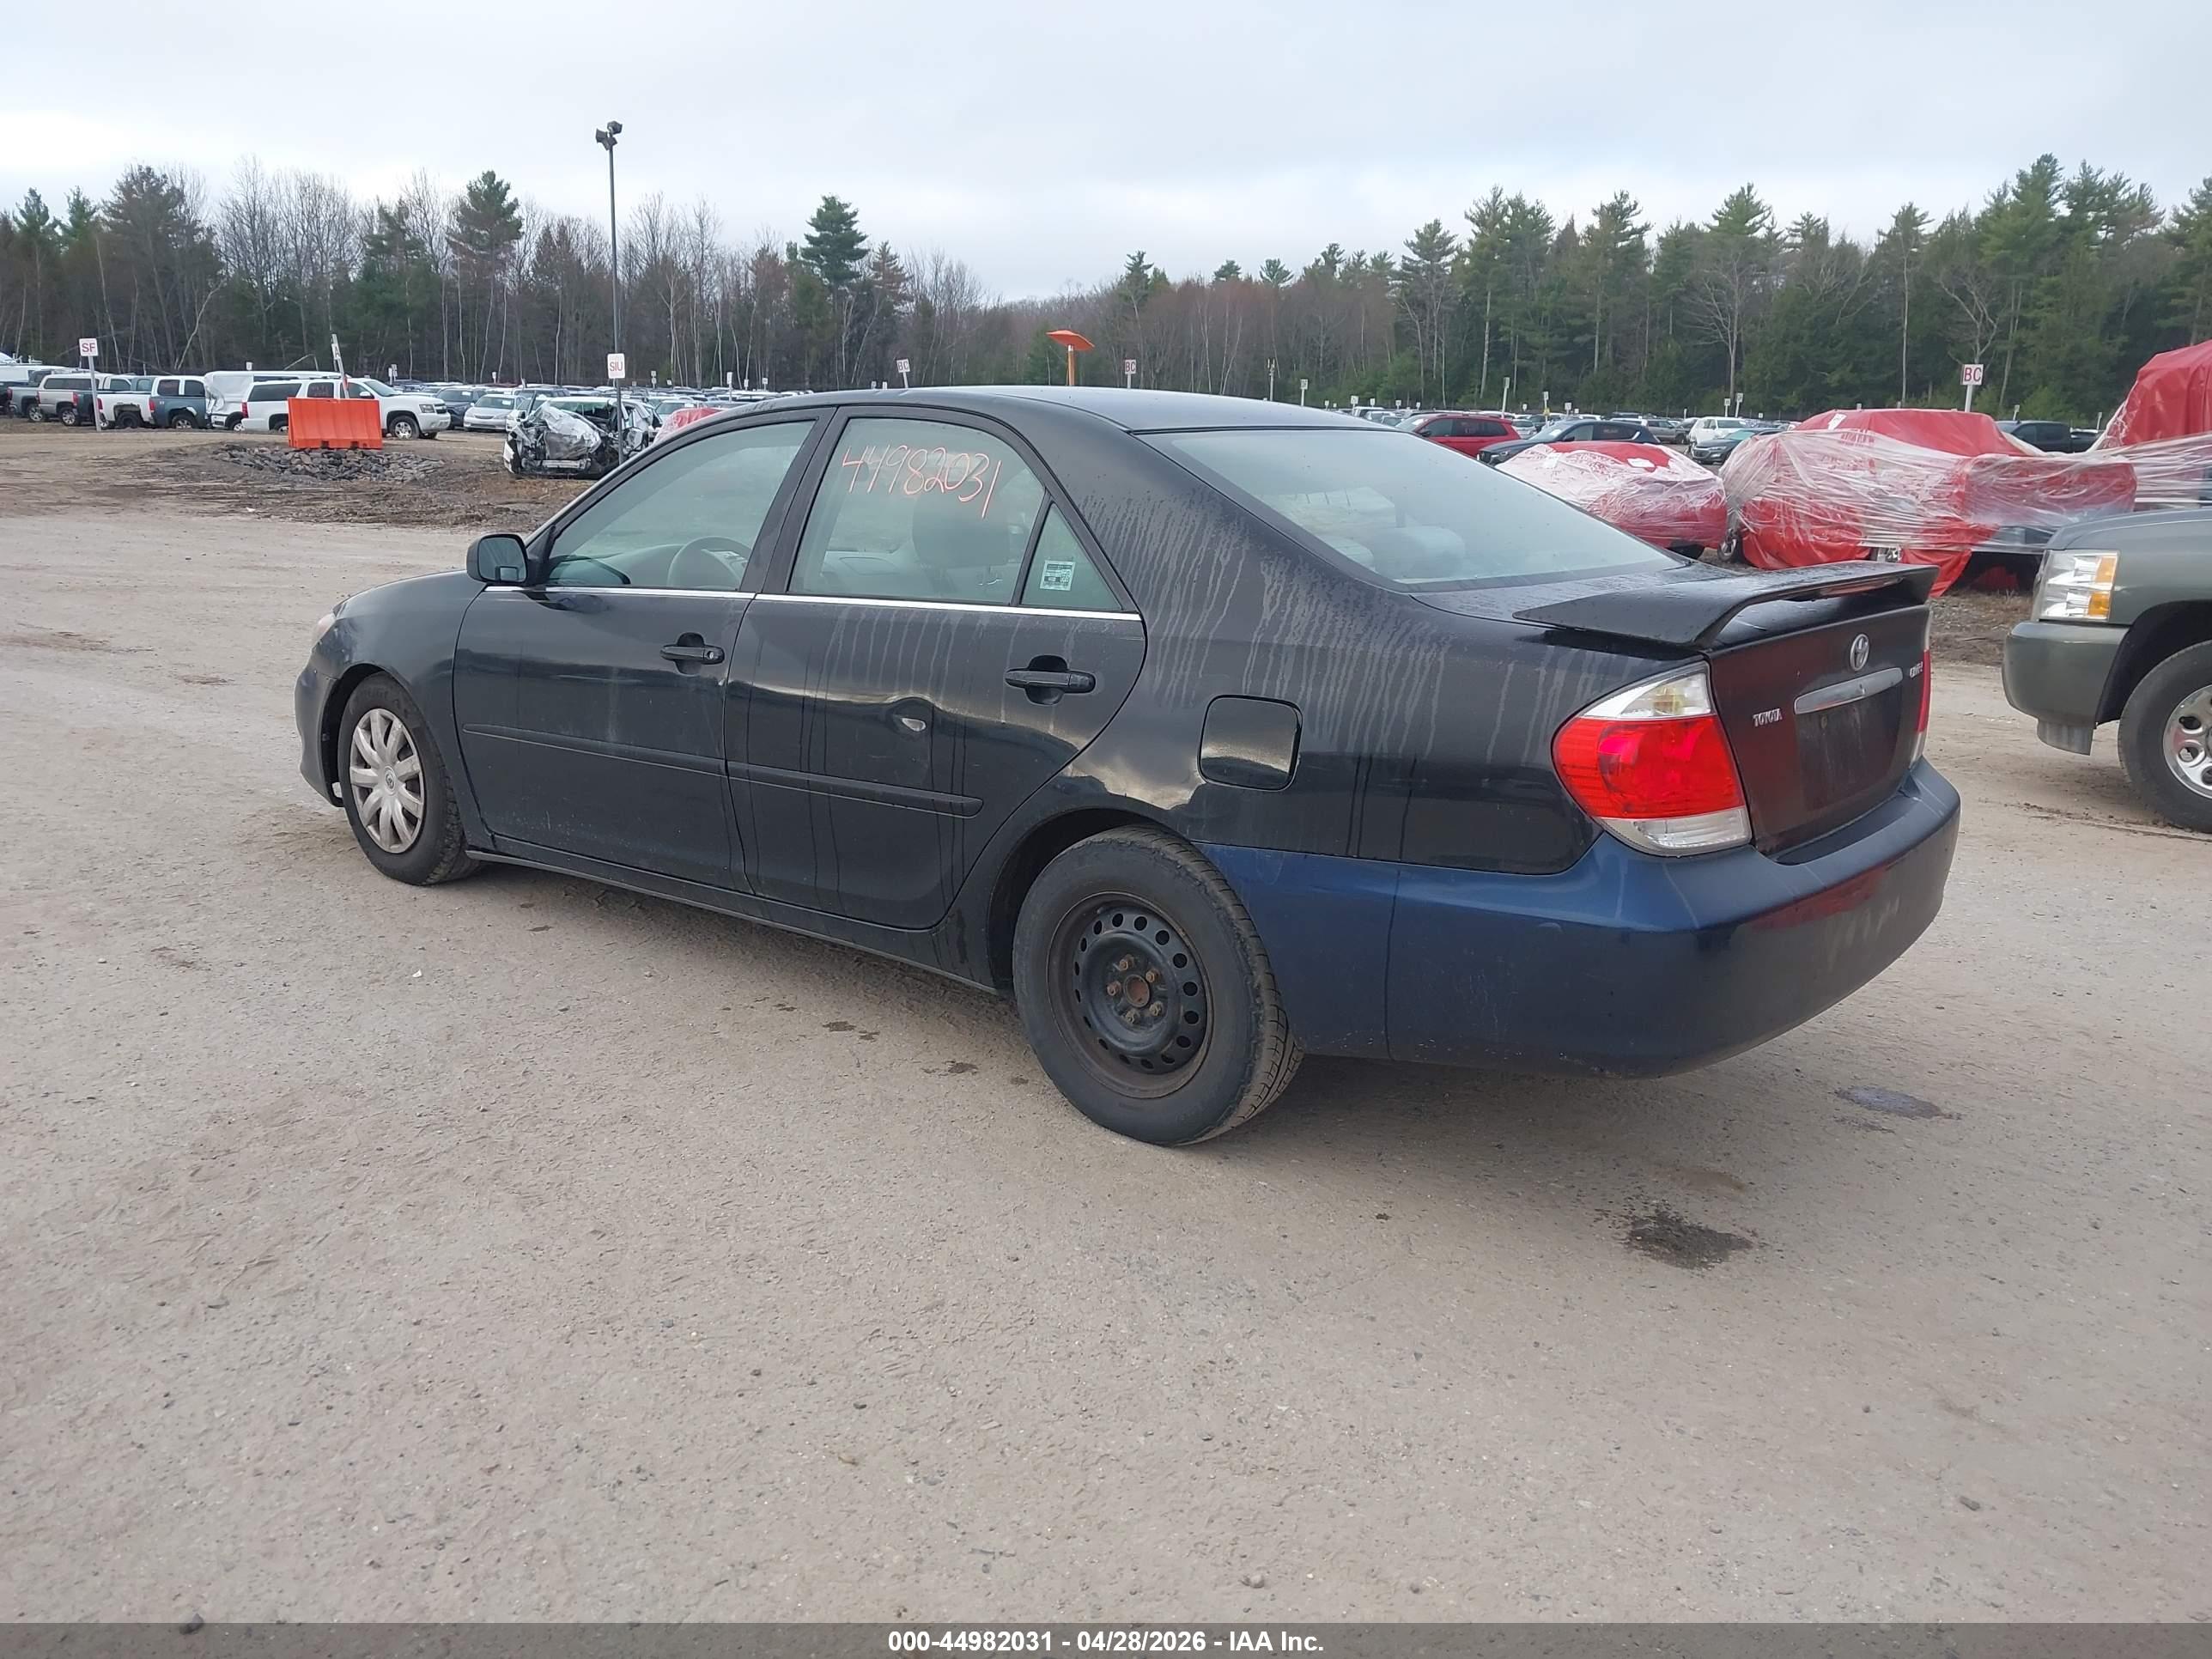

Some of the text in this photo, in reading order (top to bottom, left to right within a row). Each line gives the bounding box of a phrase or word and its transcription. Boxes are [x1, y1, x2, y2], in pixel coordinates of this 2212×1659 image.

[82, 343, 95, 352] SF
[609, 361, 623, 372] SIU
[1125, 361, 1135, 372] BC
[1964, 367, 1982, 381] BC
[842, 444, 1002, 519] 44982031
